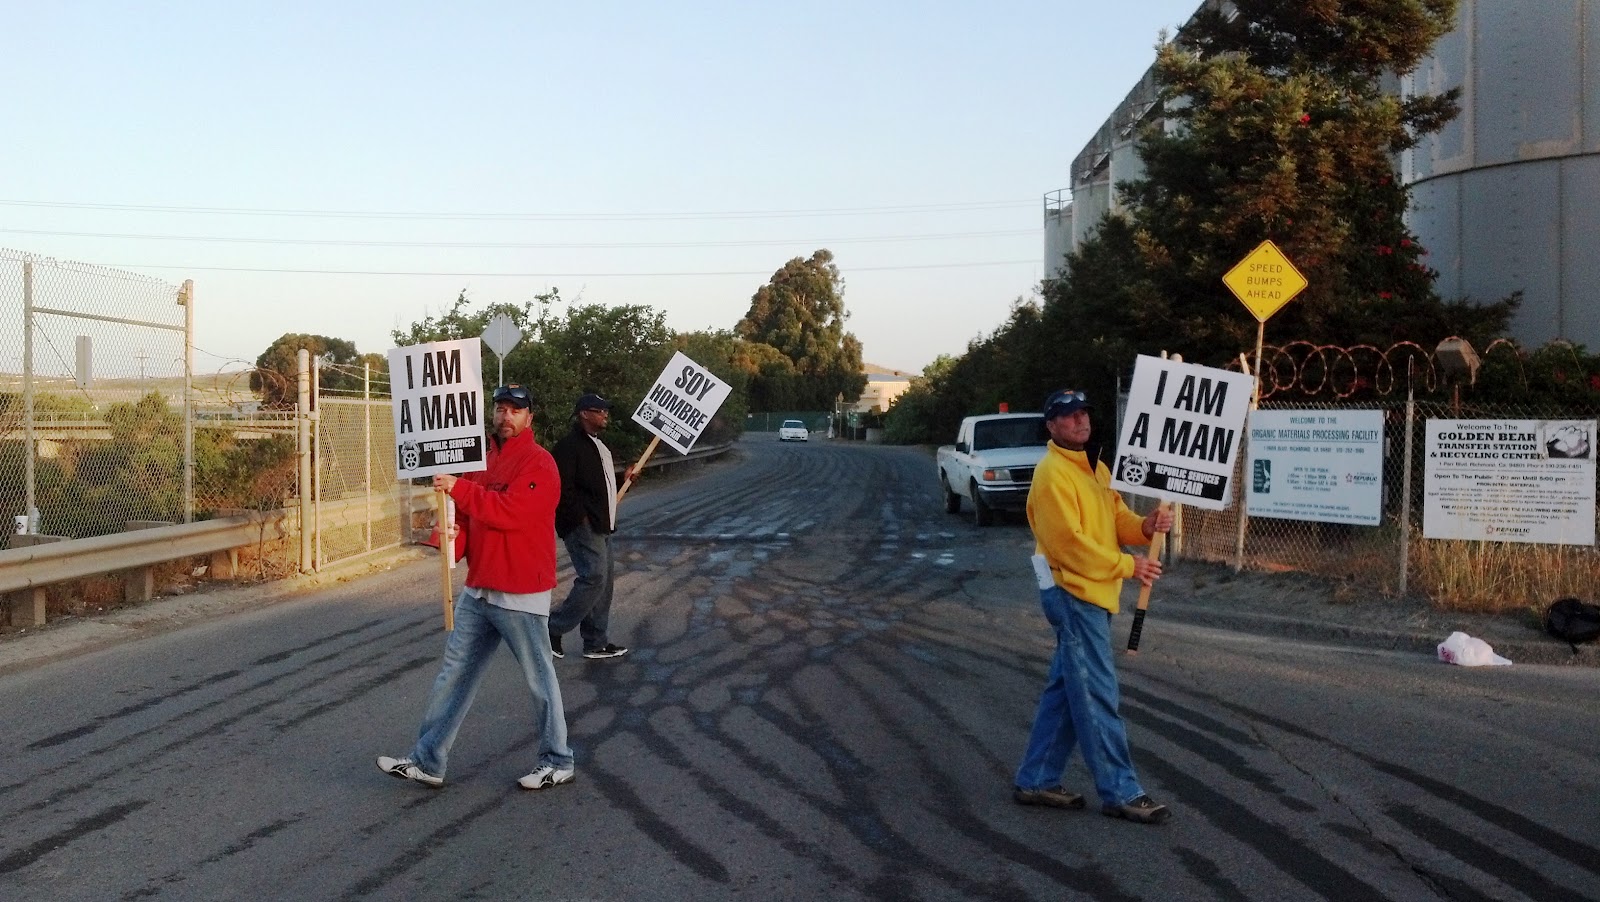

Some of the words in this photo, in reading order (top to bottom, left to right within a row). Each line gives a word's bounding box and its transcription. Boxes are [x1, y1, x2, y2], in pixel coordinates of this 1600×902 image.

[1250, 264, 1282, 273] SPEED
[1247, 276, 1282, 286] BUMPS
[1246, 290, 1281, 299] AHEAD
[406, 355, 414, 389] I
[422, 349, 462, 387] AM
[675, 366, 716, 401] SOY
[1154, 370, 1168, 406] I
[1174, 374, 1228, 417] AM
[400, 399, 413, 434] A
[420, 391, 477, 431] MAN
[650, 384, 708, 431] HOMBRE
[1128, 412, 1150, 449] A
[1159, 417, 1234, 464] MAN
[1252, 429, 1276, 439] ORGANIC
[1278, 429, 1310, 439] MATERIALS
[1313, 430, 1350, 440] PROCESSING
[1352, 430, 1378, 440] FACILITY
[1438, 432, 1494, 441] GOLDEN
[1499, 433, 1536, 442] BEAR
[424, 440, 448, 452] REPUBLIC
[449, 438, 476, 449] SERVICES
[434, 449, 464, 464] UNFAIR
[1155, 464, 1187, 477] REPUBLIC
[1187, 471, 1220, 485] SERVICES
[1166, 477, 1203, 496] UNFAIR
